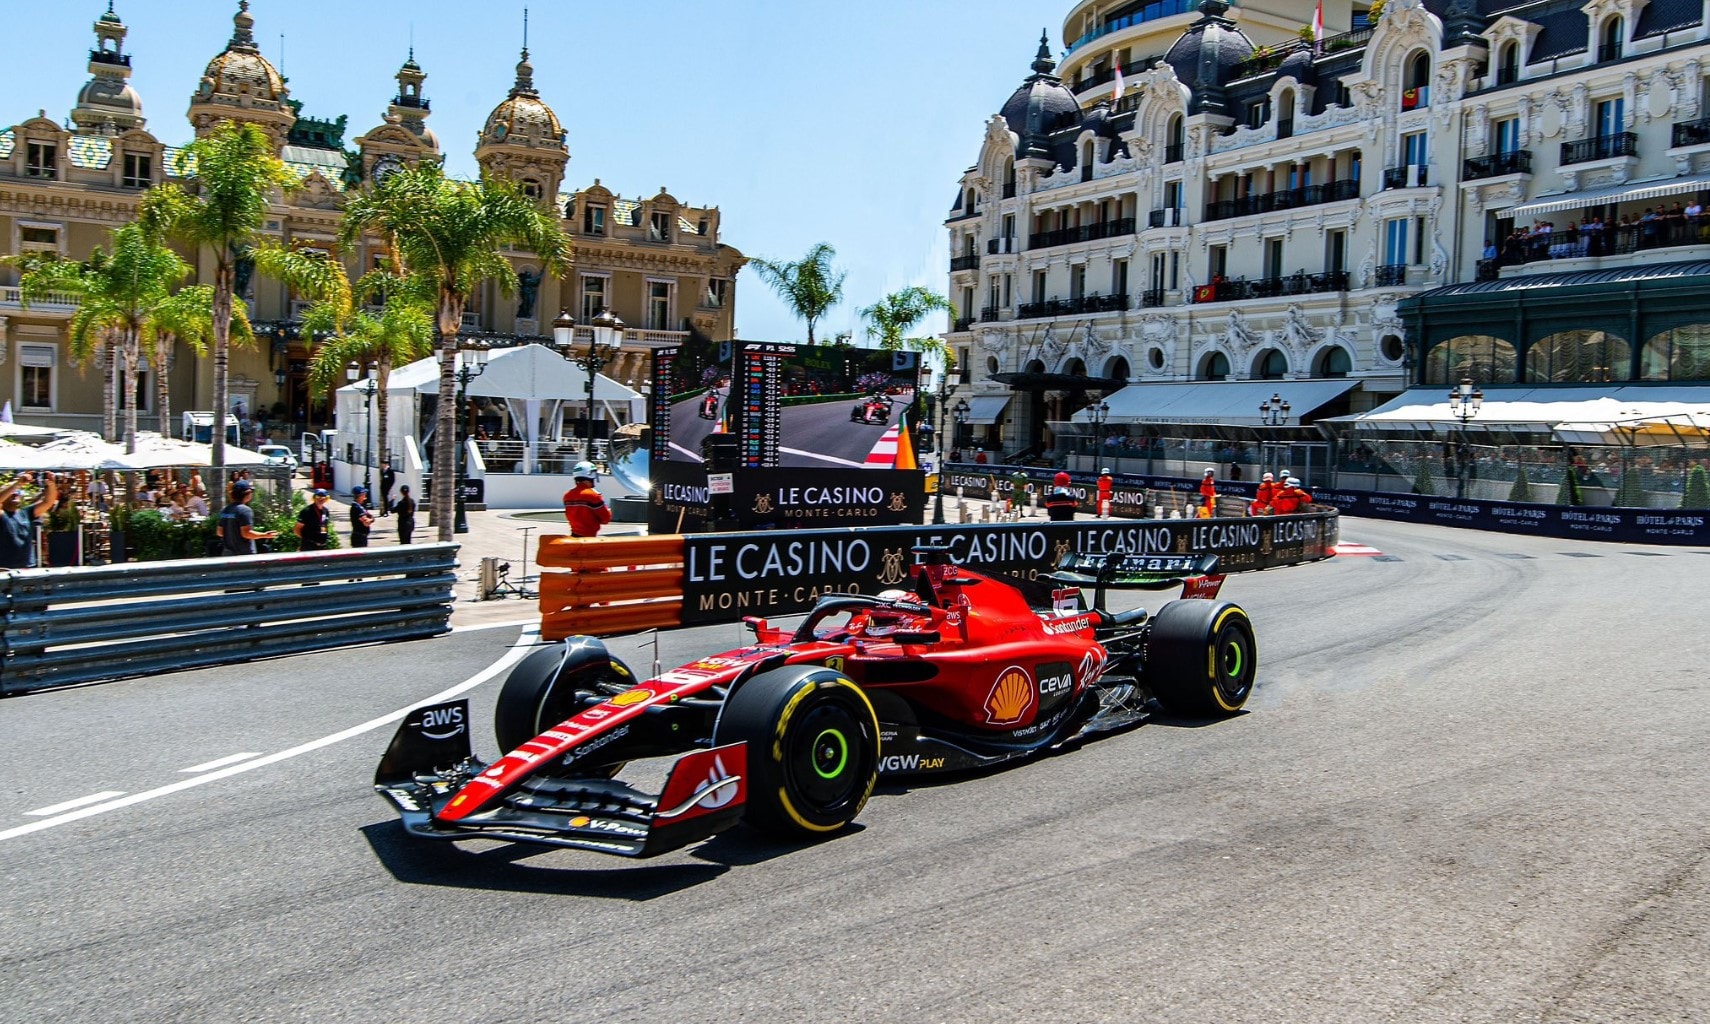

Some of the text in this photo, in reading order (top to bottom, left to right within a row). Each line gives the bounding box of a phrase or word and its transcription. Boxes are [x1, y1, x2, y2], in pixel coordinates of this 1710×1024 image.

[960, 476, 987, 488] CASINO
[664, 482, 674, 499] LE
[674, 484, 711, 504] CASINO
[778, 487, 884, 505] LE CASINO
[1523, 508, 1546, 519] PARIS
[1596, 513, 1621, 524] PARIS
[1675, 516, 1704, 526] PARIS
[1100, 527, 1172, 554] CASINO
[1192, 523, 1260, 550] LE CASINO
[1273, 522, 1284, 543] LE
[948, 531, 1046, 565] CASINO
[690, 539, 870, 582] LE CASINO
[1051, 586, 1080, 618] 16
[946, 611, 961, 620] aws
[1049, 616, 1090, 634] Santander
[422, 706, 463, 728] aws
[574, 724, 630, 760] Santander
[878, 754, 945, 772] VGW PLAY
